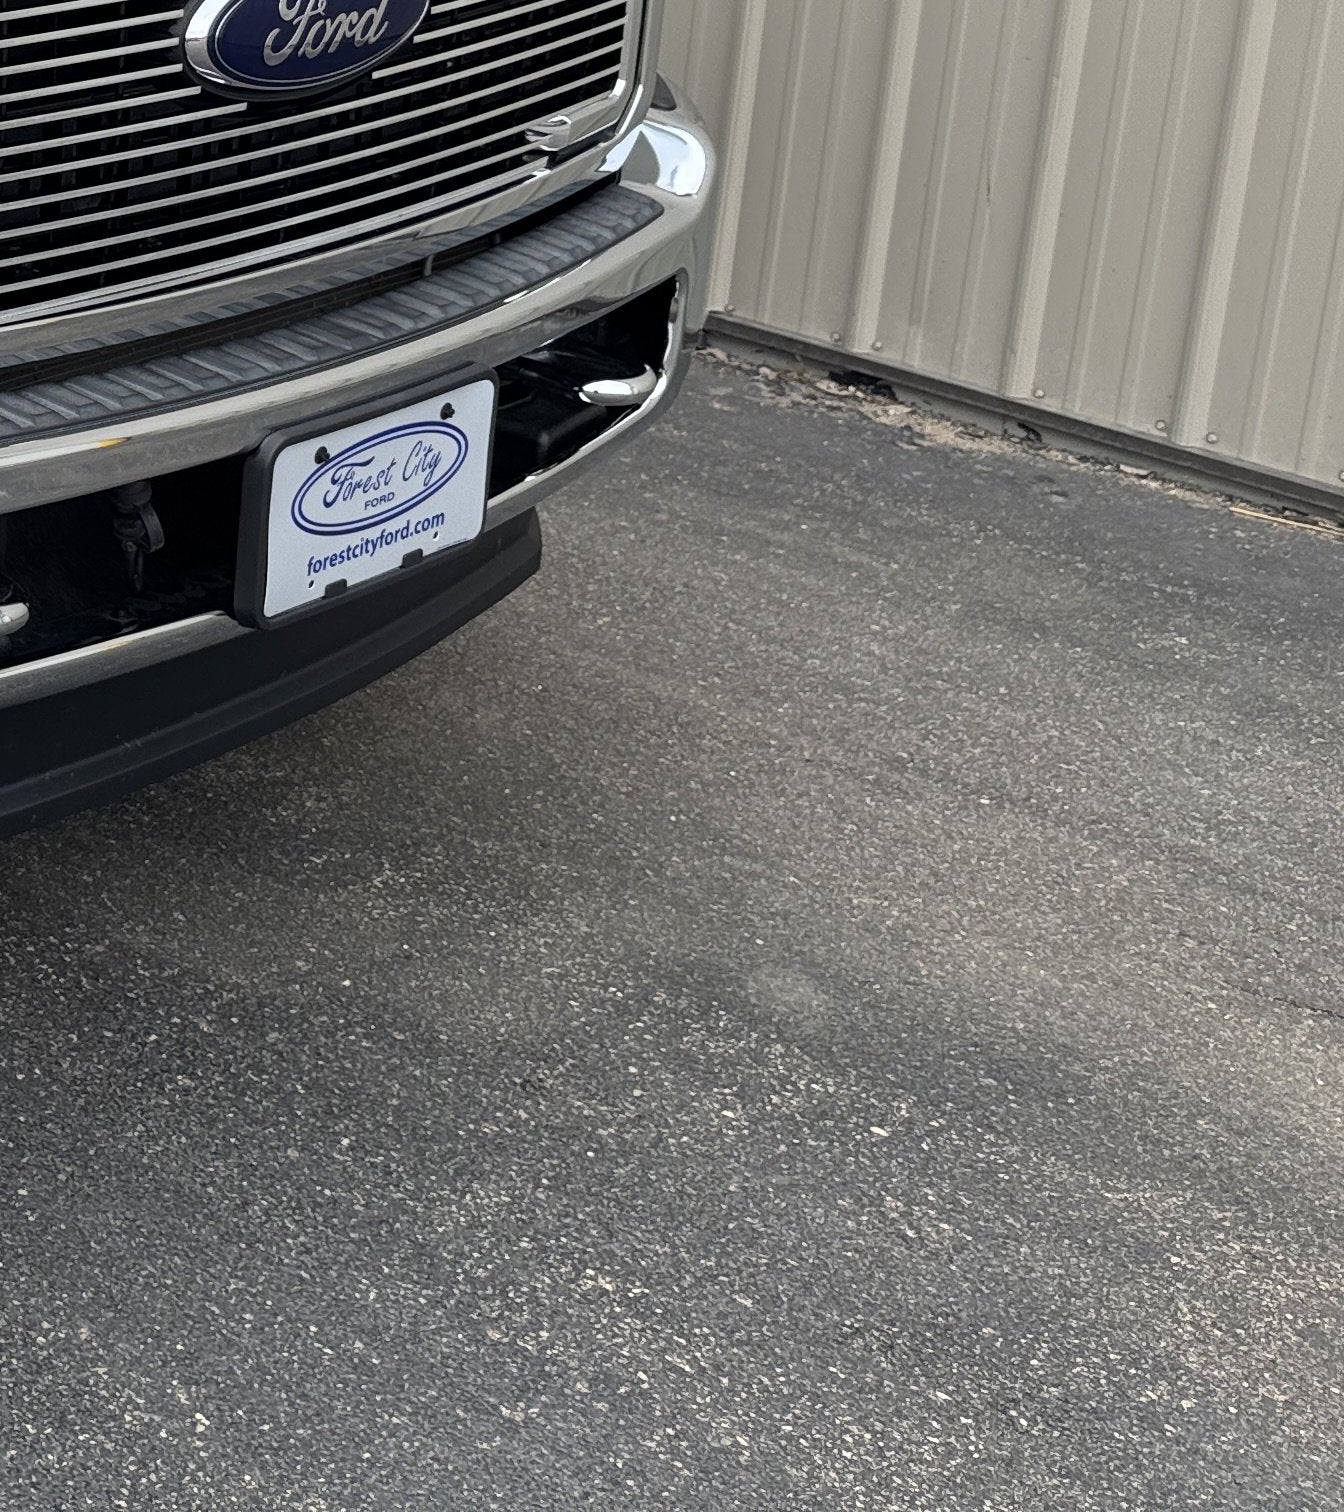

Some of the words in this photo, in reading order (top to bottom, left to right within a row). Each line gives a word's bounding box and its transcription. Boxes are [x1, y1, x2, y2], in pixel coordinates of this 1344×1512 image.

[322, 455, 396, 509] Forest
[401, 439, 442, 487] City
[363, 491, 395, 511] FORD
[306, 510, 445, 577] forestcityford.com
